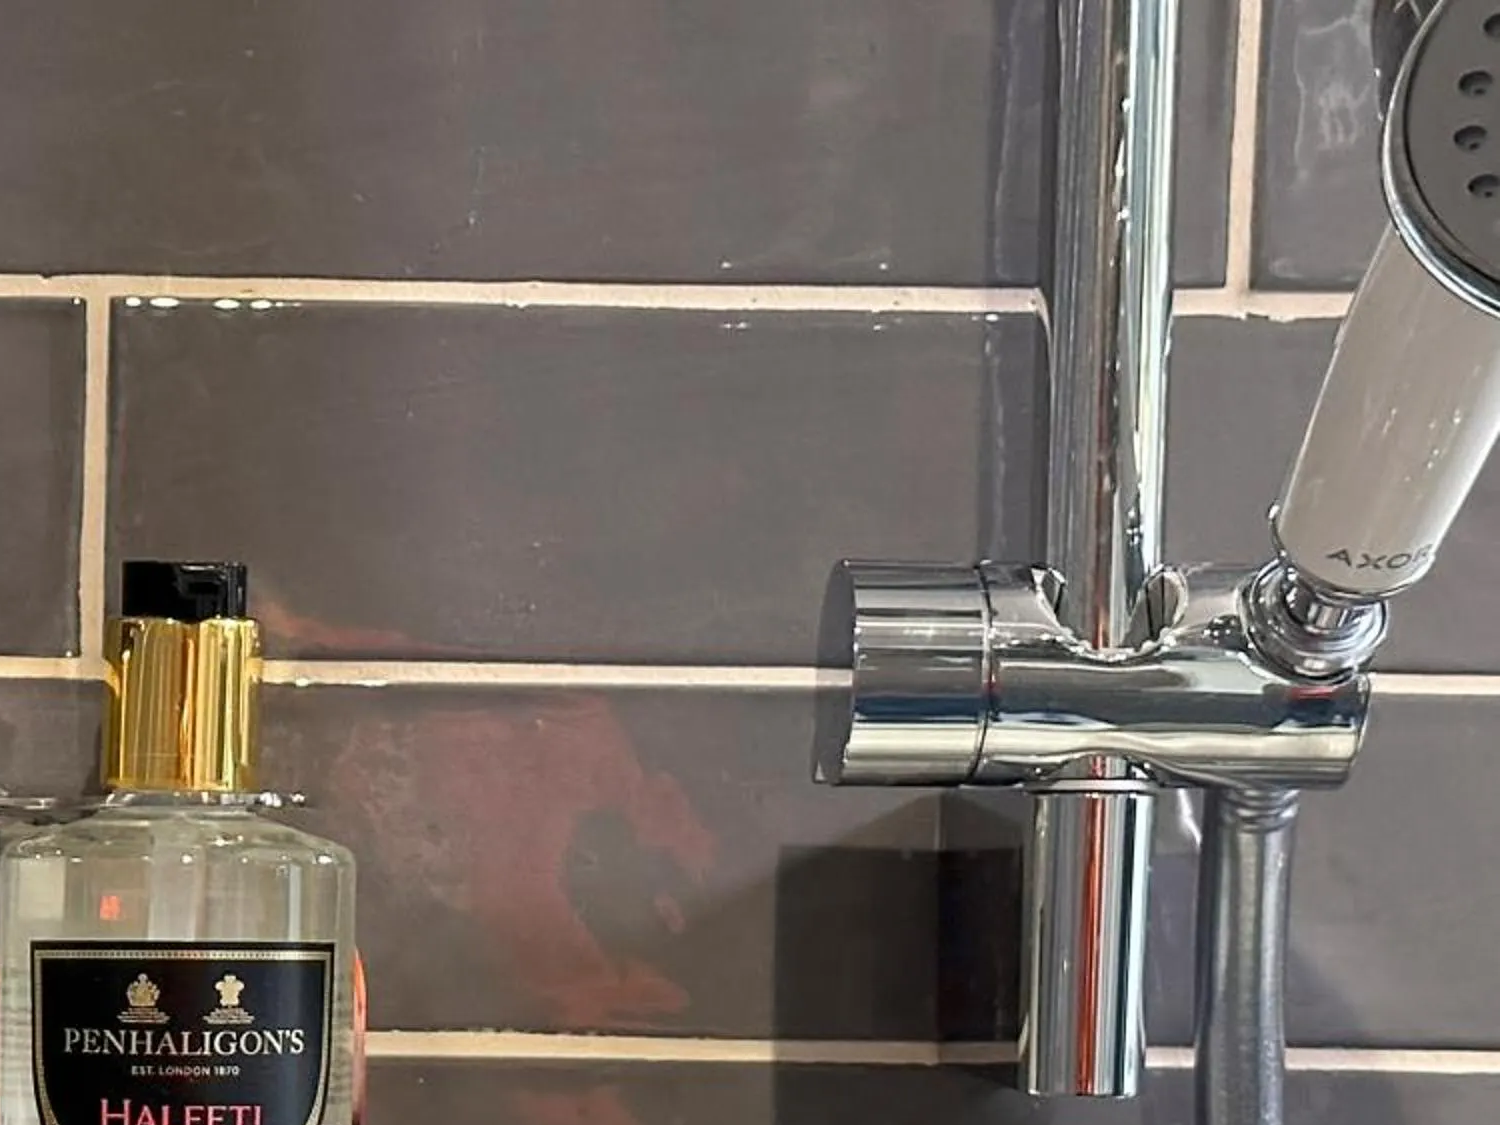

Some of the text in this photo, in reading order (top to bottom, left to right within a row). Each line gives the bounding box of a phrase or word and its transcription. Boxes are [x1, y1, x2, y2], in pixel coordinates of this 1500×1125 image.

[63, 1027, 306, 1056] PENHALIGON'S
[158, 1065, 211, 1077] LONDON
[213, 1065, 241, 1077] 1870
